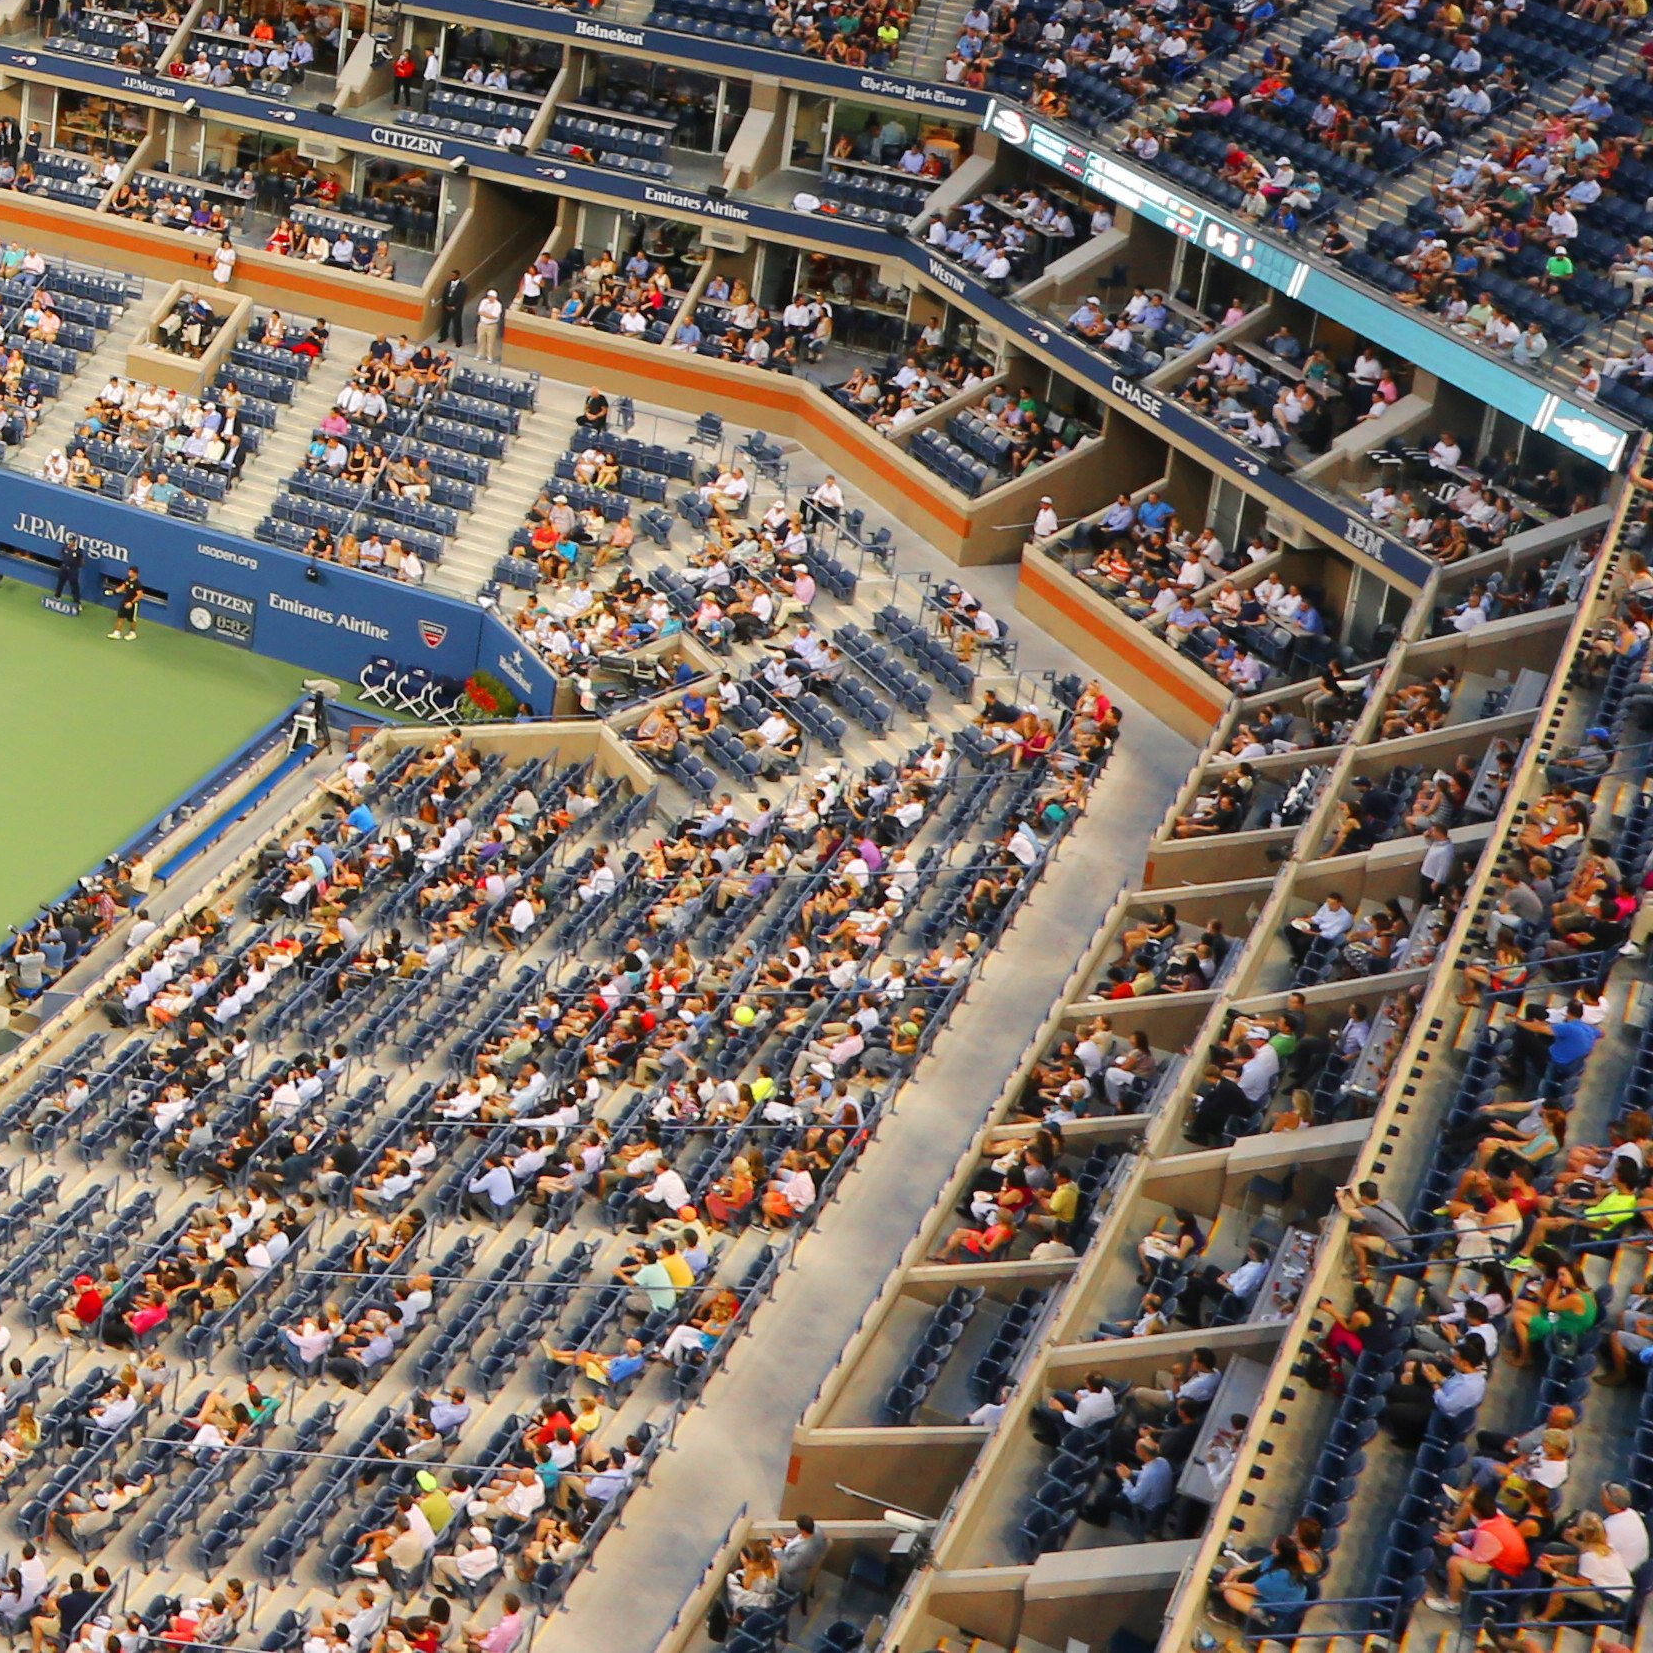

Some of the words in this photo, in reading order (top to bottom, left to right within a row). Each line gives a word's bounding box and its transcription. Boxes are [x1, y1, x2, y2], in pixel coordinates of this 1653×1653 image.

[574, 20, 645, 45] Heineken
[122, 76, 176, 97] J.P.Morgan
[860, 75, 883, 91] The
[884, 80, 906, 95] New
[907, 83, 933, 101] York
[933, 89, 968, 107] Times
[371, 128, 443, 156] CITIZEN
[645, 188, 702, 211] Emirates
[702, 200, 749, 222] Airline
[928, 258, 967, 294] WESTIN
[1111, 375, 1163, 420] CHASE
[13, 512, 129, 563] J.P.Morgan
[1344, 517, 1386, 562] IBM
[197, 544, 258, 569] usopen.org
[45, 598, 70, 614] POLO
[191, 586, 253, 615] CITIZEN
[269, 592, 334, 625] Emirates
[336, 613, 389, 641] Airline
